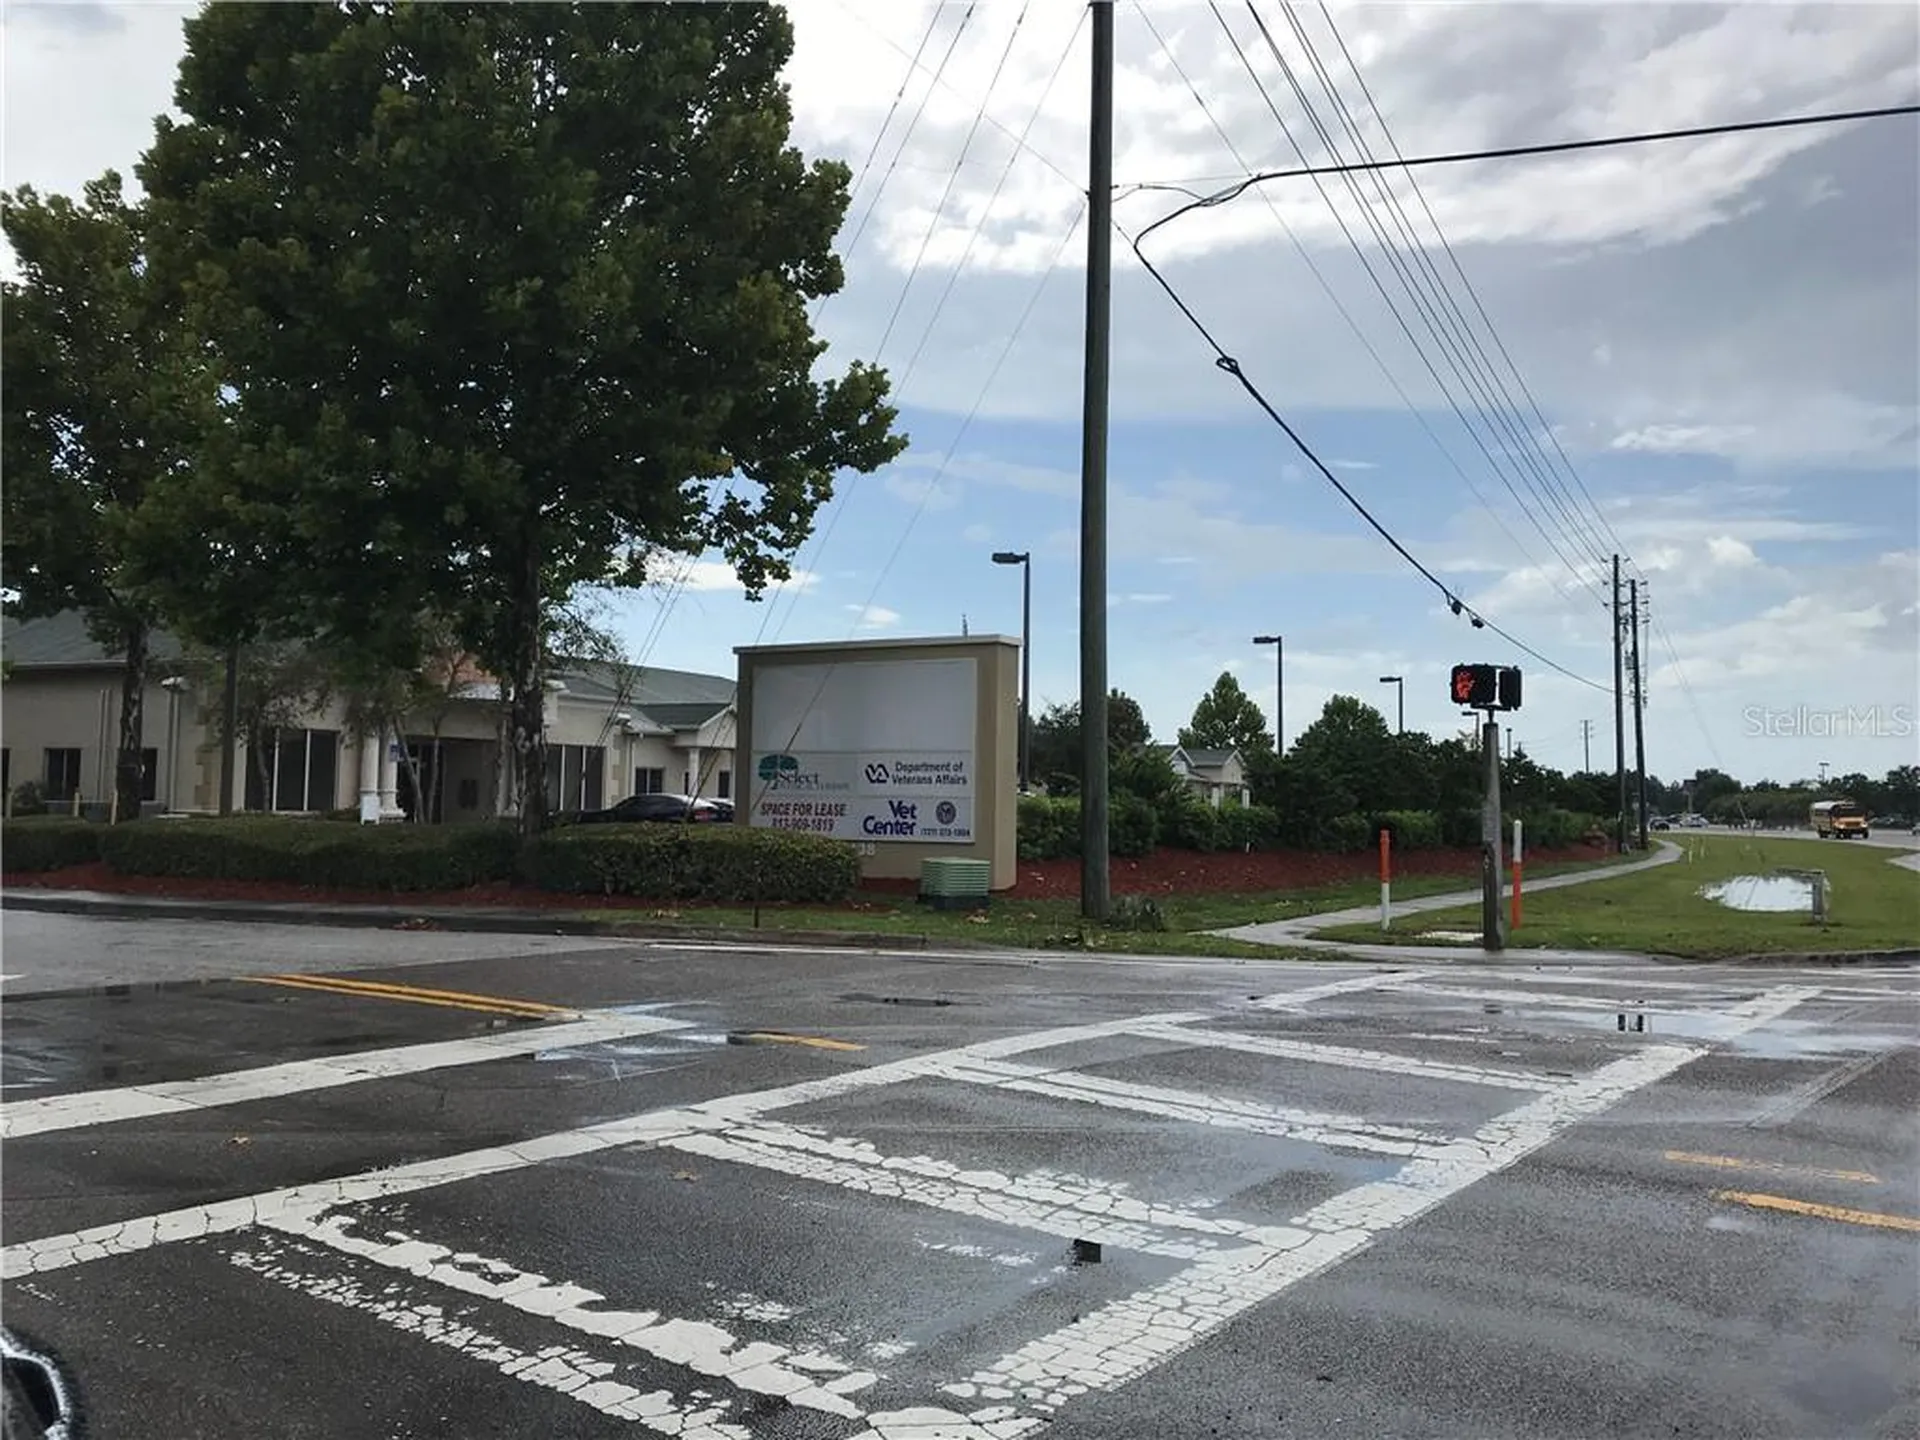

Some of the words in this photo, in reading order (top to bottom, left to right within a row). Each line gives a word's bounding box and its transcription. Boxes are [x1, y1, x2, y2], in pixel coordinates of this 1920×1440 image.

[895, 762, 951, 774] Department
[953, 761, 964, 772] of
[776, 770, 819, 785] Select
[892, 774, 933, 785] Veterans
[936, 774, 968, 786] Affairs
[761, 803, 791, 816] SPACE
[793, 802, 813, 817] FOR
[815, 802, 846, 816] LEASE
[889, 800, 917, 820] Vet
[863, 815, 917, 836] Center
